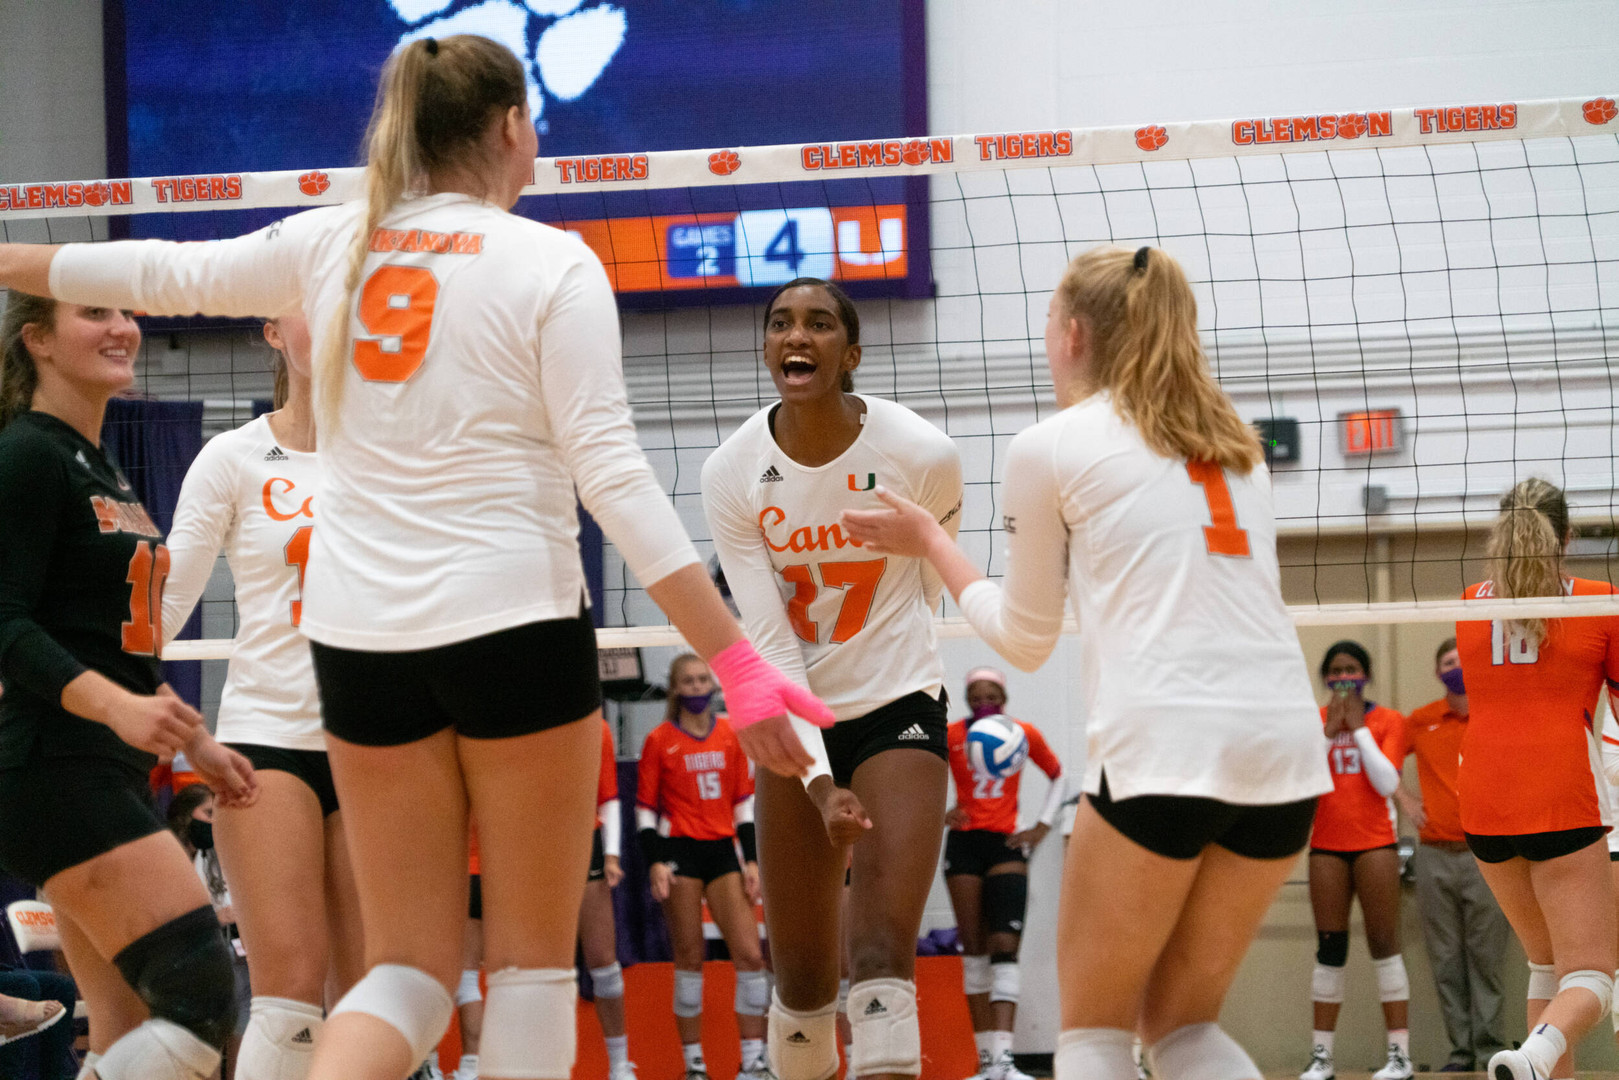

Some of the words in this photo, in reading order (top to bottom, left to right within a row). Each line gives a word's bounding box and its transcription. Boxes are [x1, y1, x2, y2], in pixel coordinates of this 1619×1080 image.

[1232, 110, 1393, 146] CLEMSON
[1414, 103, 1518, 134] TIGERS
[801, 136, 954, 171] CLEMSON
[974, 129, 1074, 161] TIGERS
[555, 154, 649, 184] TIGERS
[151, 174, 243, 203] TIGERS
[764, 218, 806, 272] 4
[837, 217, 903, 266] U
[696, 246, 720, 276] 2
[352, 264, 441, 384] 9
[760, 475, 784, 483] adidas
[848, 473, 876, 491] U
[1184, 456, 1254, 560] 1
[758, 505, 864, 554] Can
[1333, 747, 1361, 775] 13
[697, 771, 722, 800] 15
